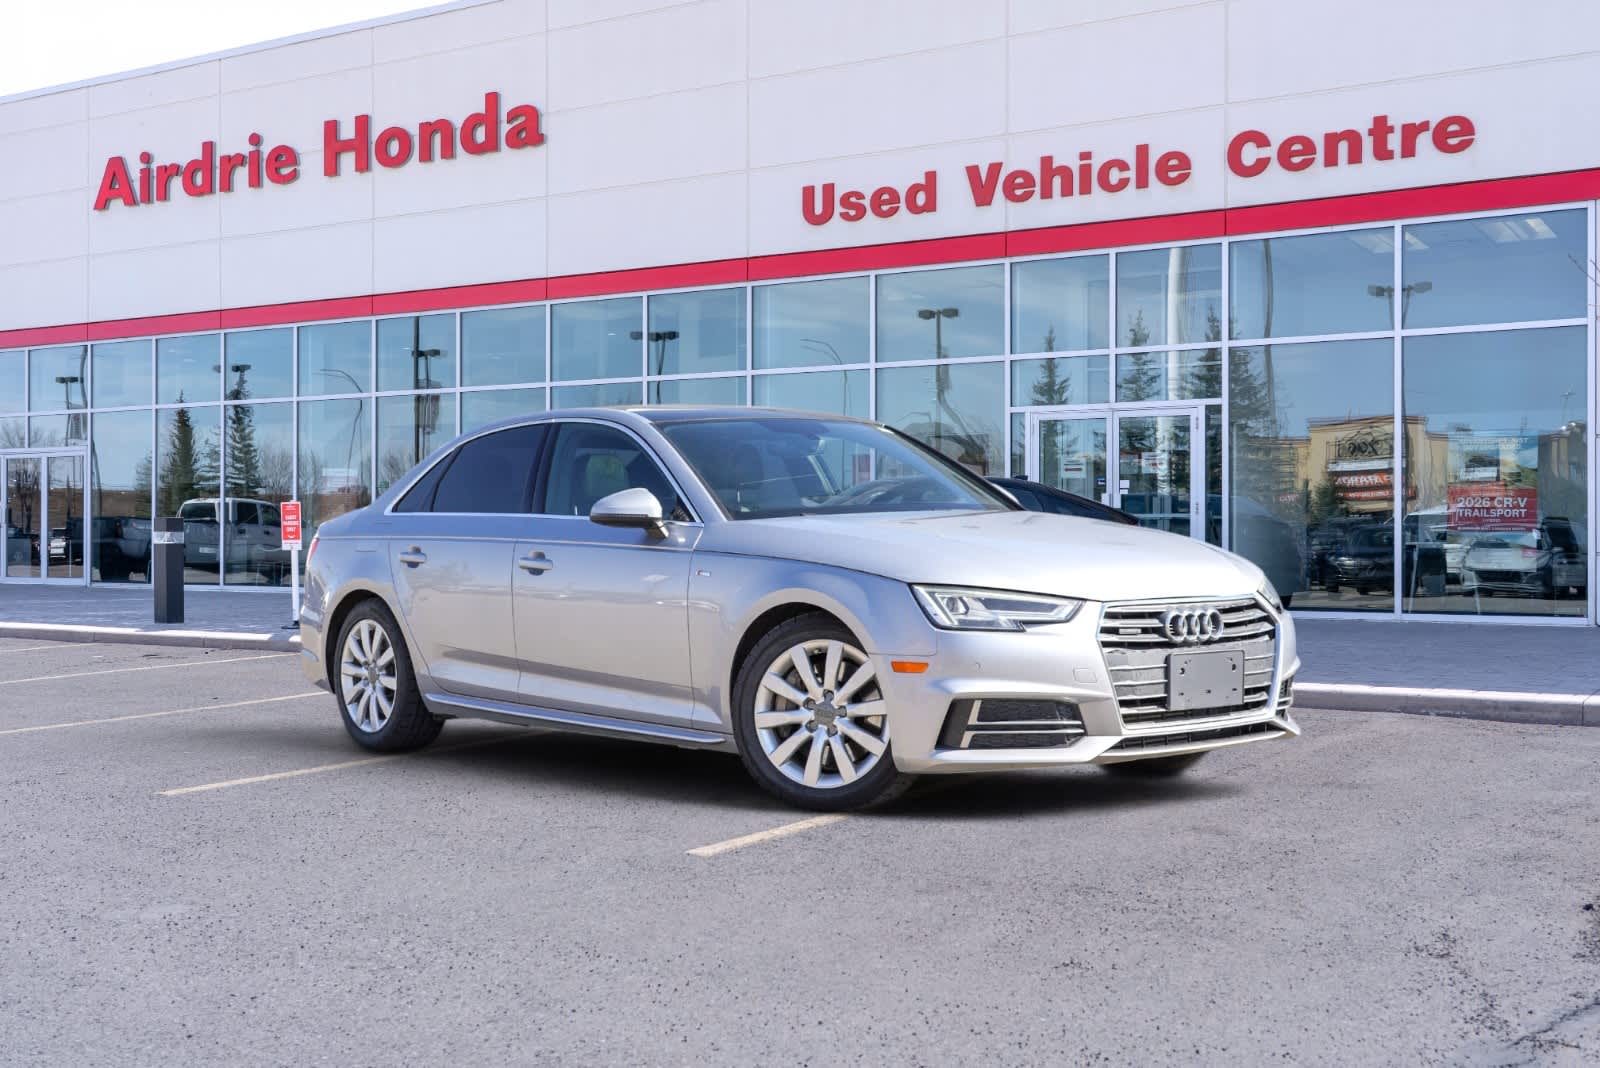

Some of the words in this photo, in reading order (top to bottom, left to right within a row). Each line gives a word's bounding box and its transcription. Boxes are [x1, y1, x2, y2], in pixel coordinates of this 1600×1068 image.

[94, 133, 298, 211] Airdrie
[323, 91, 546, 178] Honda
[802, 171, 937, 225] Used
[965, 144, 1192, 207] Vehicle
[1227, 115, 1475, 178] Centre
[1456, 497, 1490, 508] 2026
[1494, 497, 1528, 508] CR-V
[1457, 508, 1528, 518] TRAILSPORT
